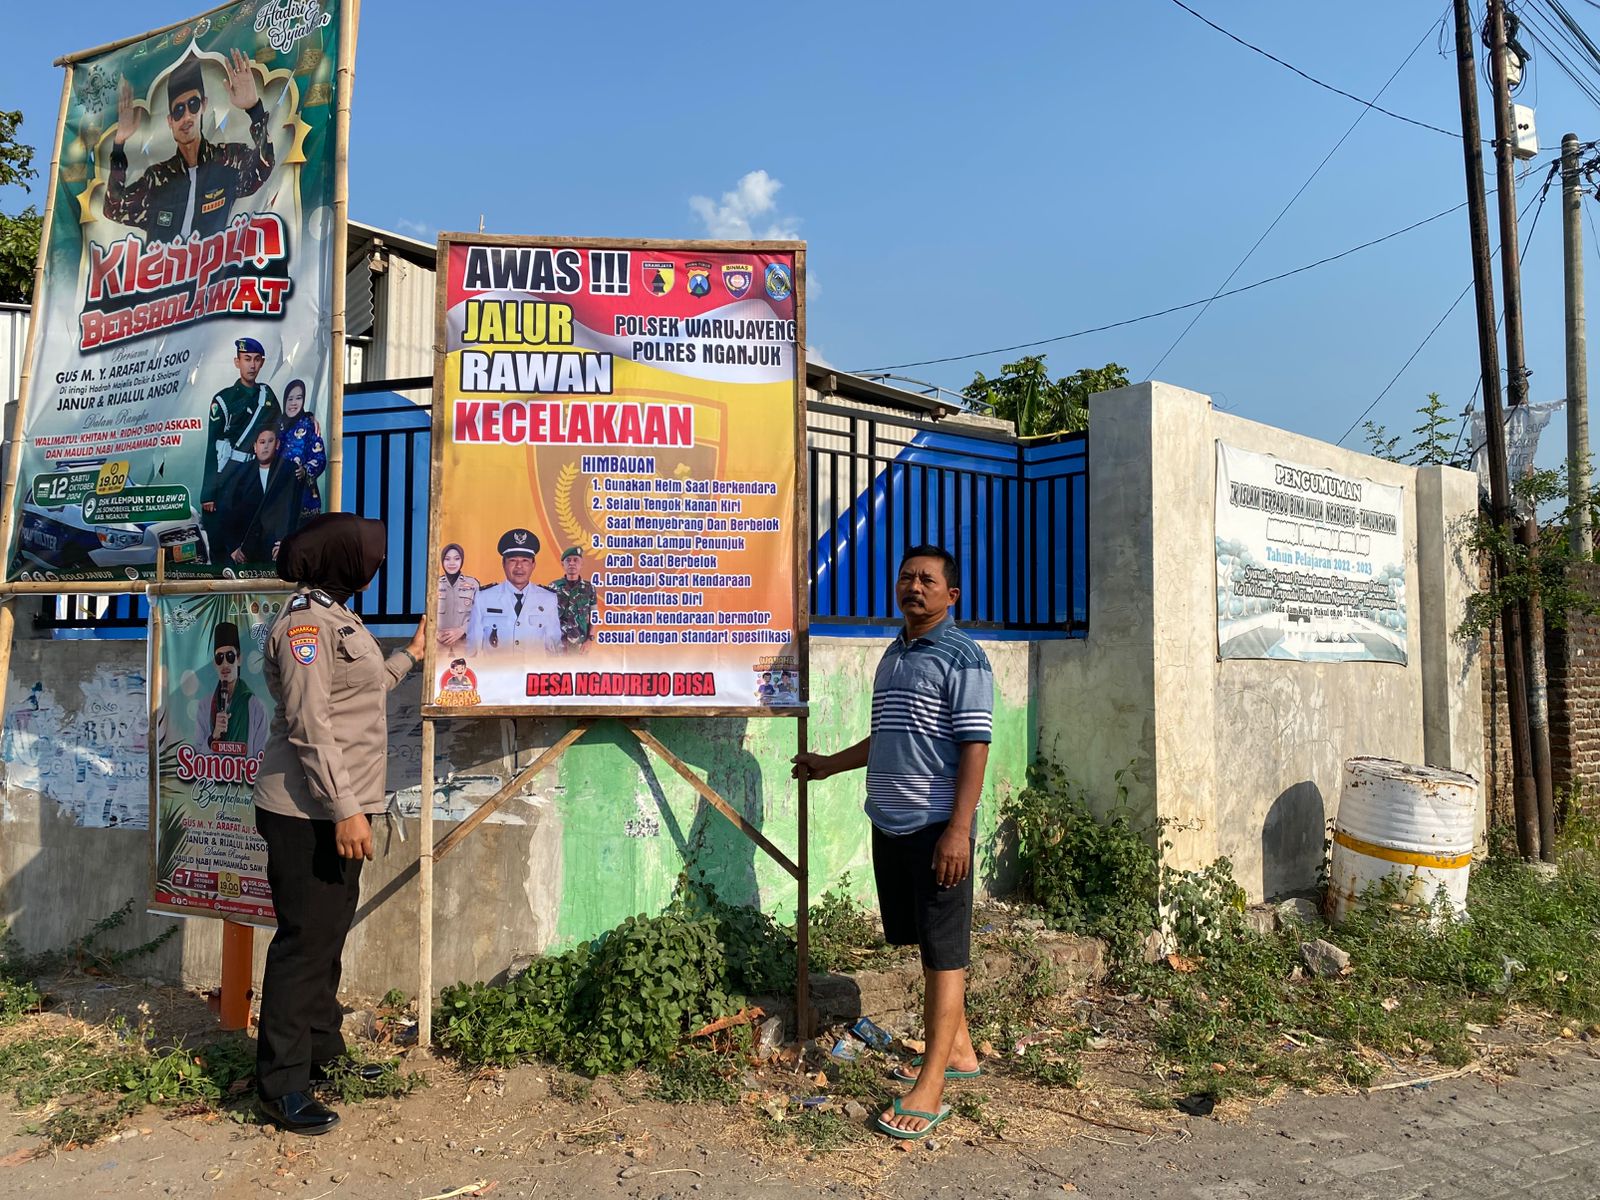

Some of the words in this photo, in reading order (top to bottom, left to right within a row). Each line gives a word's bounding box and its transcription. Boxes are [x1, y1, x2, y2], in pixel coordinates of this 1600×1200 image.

[254, 0, 305, 31] Hadiri
[463, 246, 582, 294] AWAS
[589, 251, 630, 294] !!!
[80, 277, 290, 350] BERSHOLAWAT
[462, 299, 574, 345] JALUR
[615, 314, 680, 338] POLSEK
[685, 317, 796, 342] WARUJAYENG
[632, 340, 696, 364] POLRES
[702, 342, 782, 367] NGANJUK
[56, 370, 78, 384] GUS
[81, 369, 95, 381] M.
[99, 368, 106, 380] Y.
[109, 360, 146, 378] ARAFAT
[147, 357, 163, 371] AJI
[163, 349, 190, 368] SOKO
[460, 350, 613, 395] RAWAN
[56, 396, 96, 411] JANUR
[97, 395, 104, 407] &
[107, 389, 144, 406] RIJALUL
[148, 380, 179, 398] ANSOR
[453, 400, 694, 448] KECELAKAAN
[34, 434, 78, 447] WALIMATUL
[80, 431, 108, 443] KHITAN
[120, 427, 142, 438] RIDHO
[144, 423, 164, 434] SIDIQ
[164, 418, 202, 431] ASKARI
[45, 449, 62, 459] DAN
[64, 446, 94, 459] MAULID
[95, 444, 113, 455] NABI
[114, 437, 158, 453] MUHAMMAD
[160, 435, 181, 446] SAW
[581, 456, 655, 474] HIMBAUAN
[70, 475, 90, 483] SABTU
[99, 474, 125, 487] 19.00
[592, 478, 601, 491] 1.
[604, 478, 651, 492] Gunakan
[655, 479, 682, 492] Helm
[685, 480, 709, 493] Saat
[712, 481, 777, 494] Berkendara
[1275, 464, 1362, 502] PENGUMUMAN
[49, 477, 69, 499] 12
[69, 483, 95, 492] OKTOBER
[111, 496, 144, 505] KLEMPUN
[146, 495, 155, 503] RT
[156, 495, 165, 503] 01
[165, 494, 177, 502] RW
[178, 493, 186, 501] 01
[592, 498, 603, 510] 2.
[606, 498, 640, 511] Selalu
[644, 498, 681, 513] Tengok
[684, 499, 717, 512] Kanan
[720, 500, 741, 513] Kiri
[606, 516, 632, 530] Saat
[634, 516, 704, 531] Menyebrang
[707, 518, 727, 531] Dan
[730, 518, 779, 531] Berbelok
[592, 535, 603, 548] 3.
[606, 535, 654, 548] Gunakan
[657, 536, 692, 550] Lampu
[695, 537, 745, 551] Penunjuk
[606, 554, 634, 567] Arah
[639, 554, 665, 567] Saat
[667, 555, 717, 568] Berbelok
[1266, 546, 1293, 565] Tahun
[1295, 550, 1332, 570] Pelajaran
[1333, 558, 1351, 571] 2022
[1356, 561, 1373, 576] 2023
[591, 574, 603, 586] 4.
[606, 573, 655, 588] Lengkapi
[658, 573, 689, 587] Surat
[692, 574, 751, 588] Kendaraan
[605, 592, 627, 605] Dan
[629, 592, 679, 606] Identitas
[681, 593, 703, 606] Diri
[591, 611, 602, 624] 5.
[605, 611, 653, 625] Gunakan
[656, 611, 715, 625] kendaraan
[718, 611, 771, 625] bermotor
[1271, 603, 1285, 613] Pada
[1286, 605, 1297, 614] Jam
[1298, 606, 1312, 617] Kerja
[1313, 607, 1329, 617] Pukul
[598, 630, 635, 643] sesuai
[638, 630, 679, 645] dengan
[681, 630, 729, 644] standart
[731, 631, 791, 645] spesifikasi
[526, 673, 573, 696] DESA
[575, 672, 670, 698] NGADIREJO
[672, 672, 716, 697] BISA
[439, 689, 477, 699] BOLOKU
[218, 743, 242, 752] DUSUN
[177, 744, 265, 785] Sonore
[182, 818, 196, 828] GUS
[216, 821, 240, 833] ARAFAT
[185, 870, 191, 886] 7
[220, 882, 239, 892] 19.00
